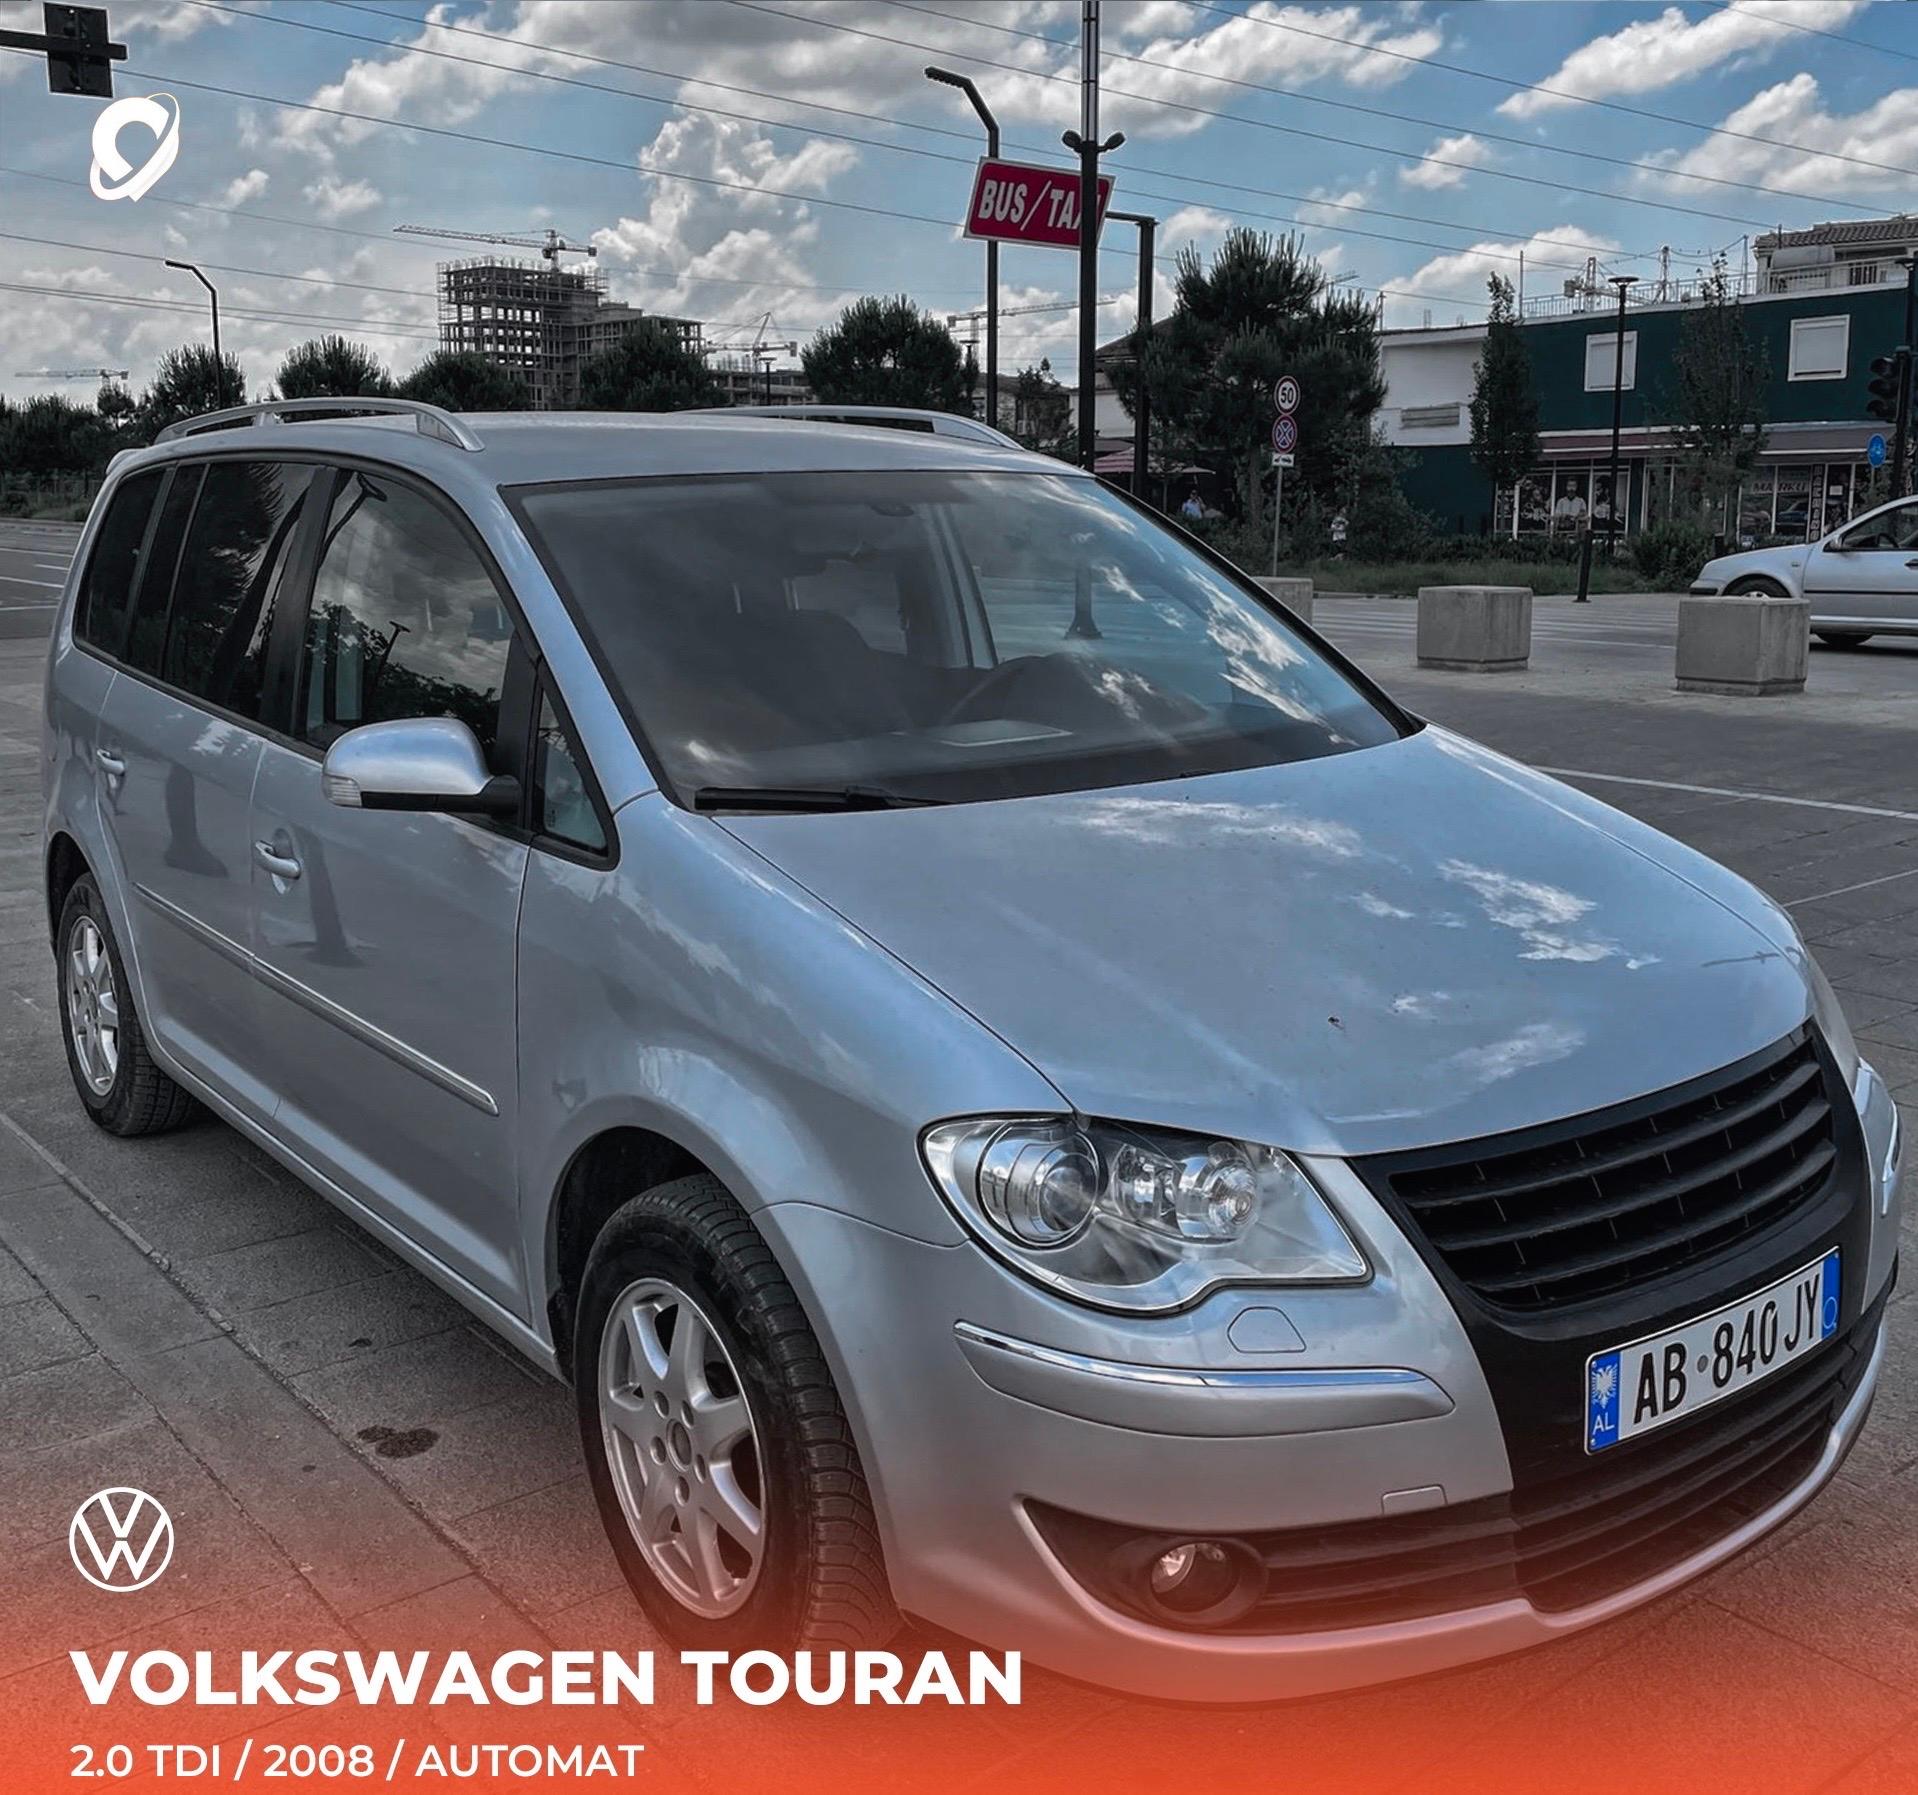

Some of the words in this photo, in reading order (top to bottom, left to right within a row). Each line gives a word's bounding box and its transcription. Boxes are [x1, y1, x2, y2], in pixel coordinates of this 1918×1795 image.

[978, 179, 1100, 231] BUS/TA
[1280, 386, 1295, 404] 50
[1633, 1343, 1687, 1425] AB
[1712, 1300, 1778, 1389] 840
[1784, 1273, 1820, 1352] JY
[1592, 1412, 1616, 1436] AL
